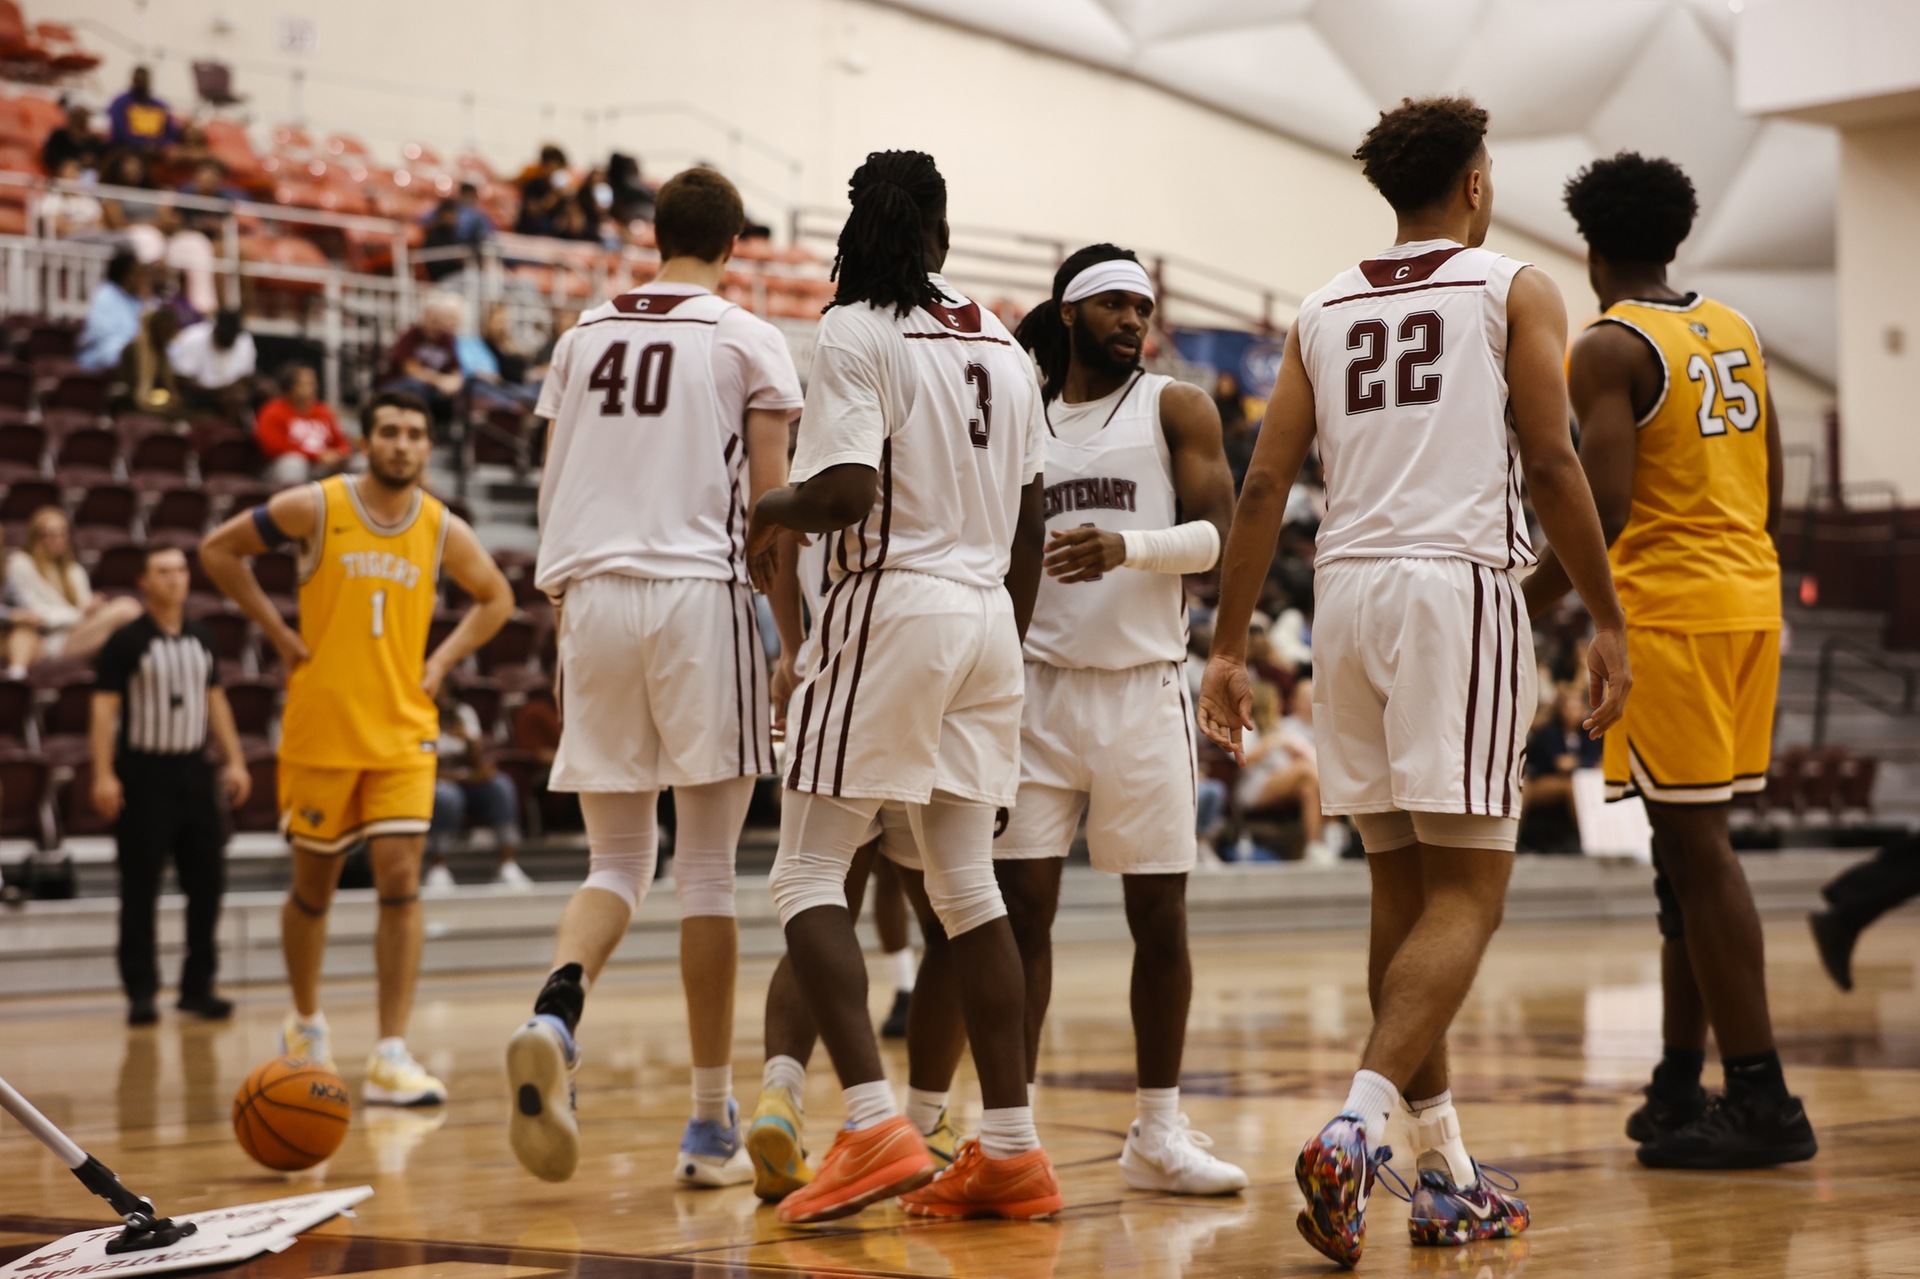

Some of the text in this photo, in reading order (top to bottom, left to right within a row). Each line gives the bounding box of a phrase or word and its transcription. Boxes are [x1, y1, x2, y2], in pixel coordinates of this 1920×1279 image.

[1395, 266, 1410, 280] C
[635, 298, 651, 311] C
[588, 340, 676, 417] 40
[1346, 310, 1443, 416] 22
[964, 361, 992, 449] 3
[1687, 348, 1761, 438] 25
[1043, 477, 1137, 521] ENTENARY
[339, 550, 422, 590] TIGERS
[370, 588, 387, 640] 1
